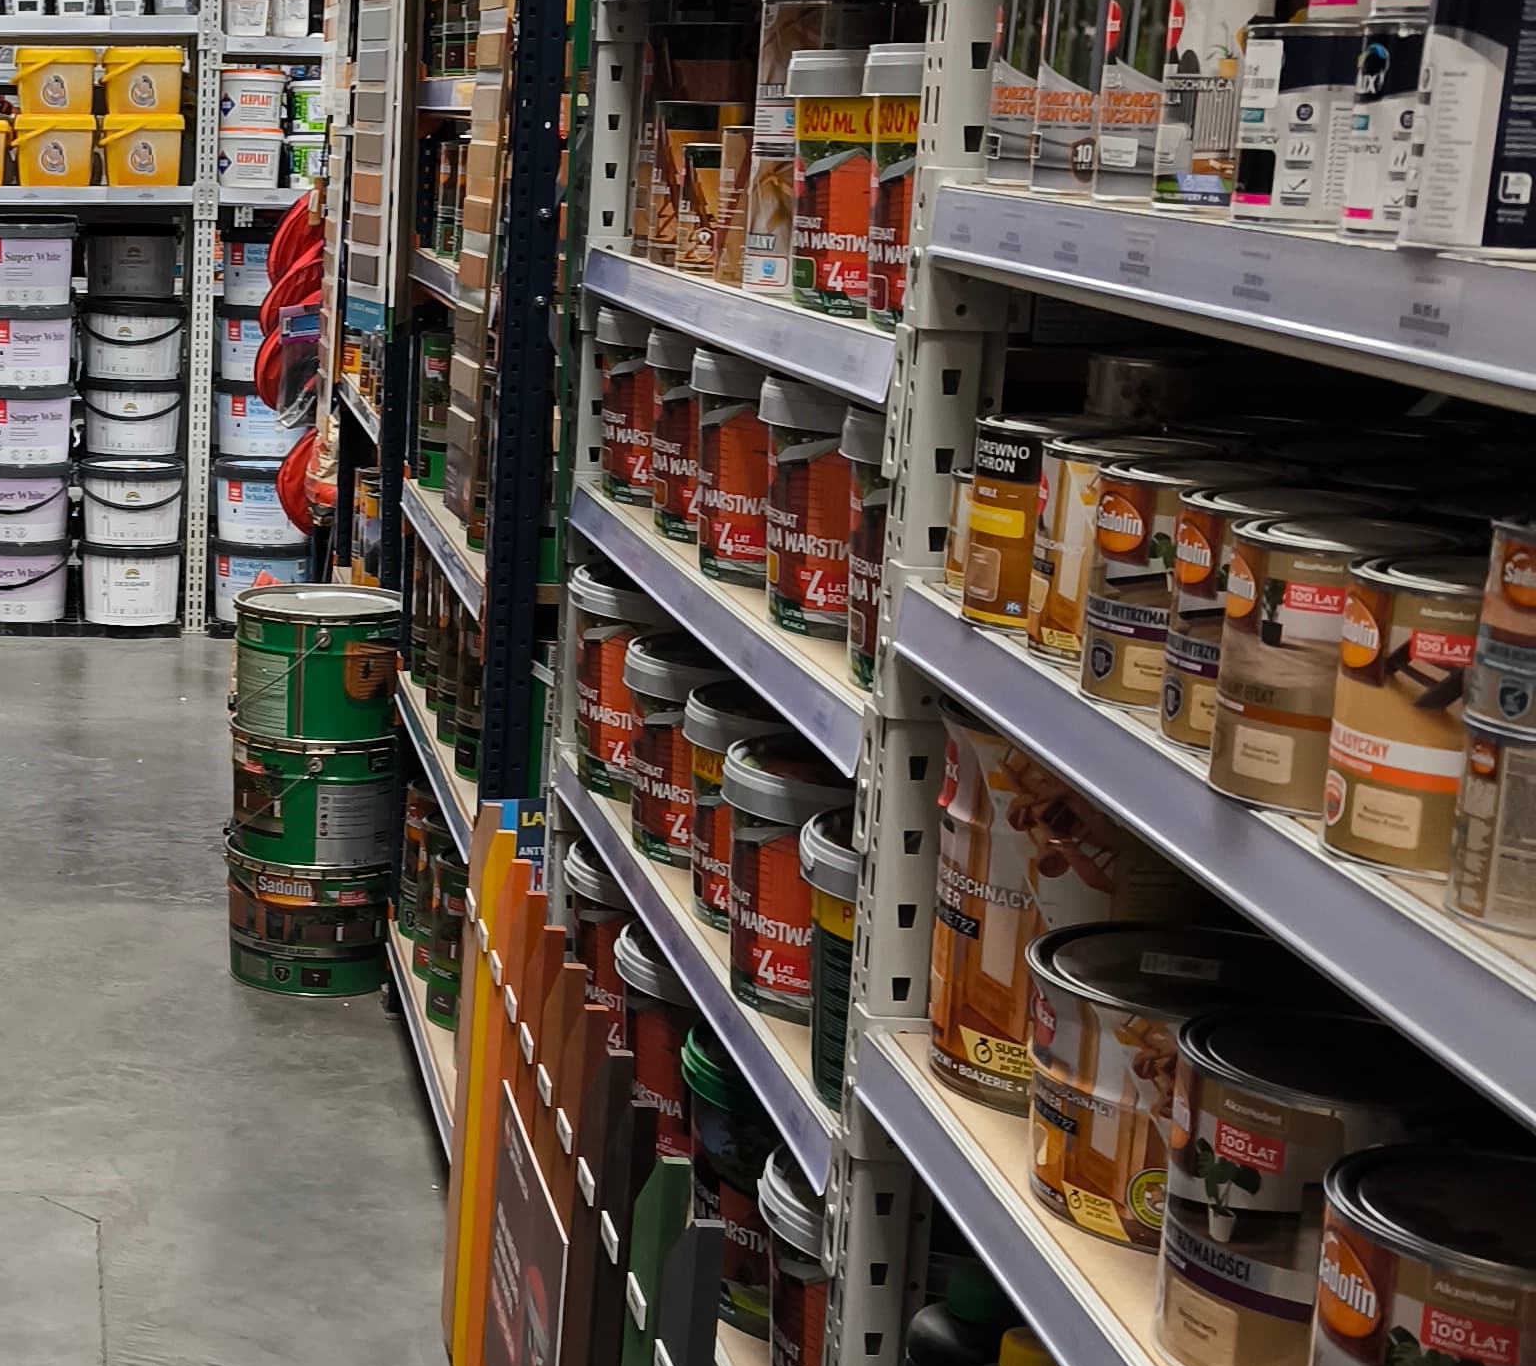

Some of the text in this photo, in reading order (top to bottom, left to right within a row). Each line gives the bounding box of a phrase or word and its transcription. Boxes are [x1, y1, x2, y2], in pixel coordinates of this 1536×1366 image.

[258, 875, 314, 898] Sadolin
[1429, 1321, 1510, 1354] 100 LAT
